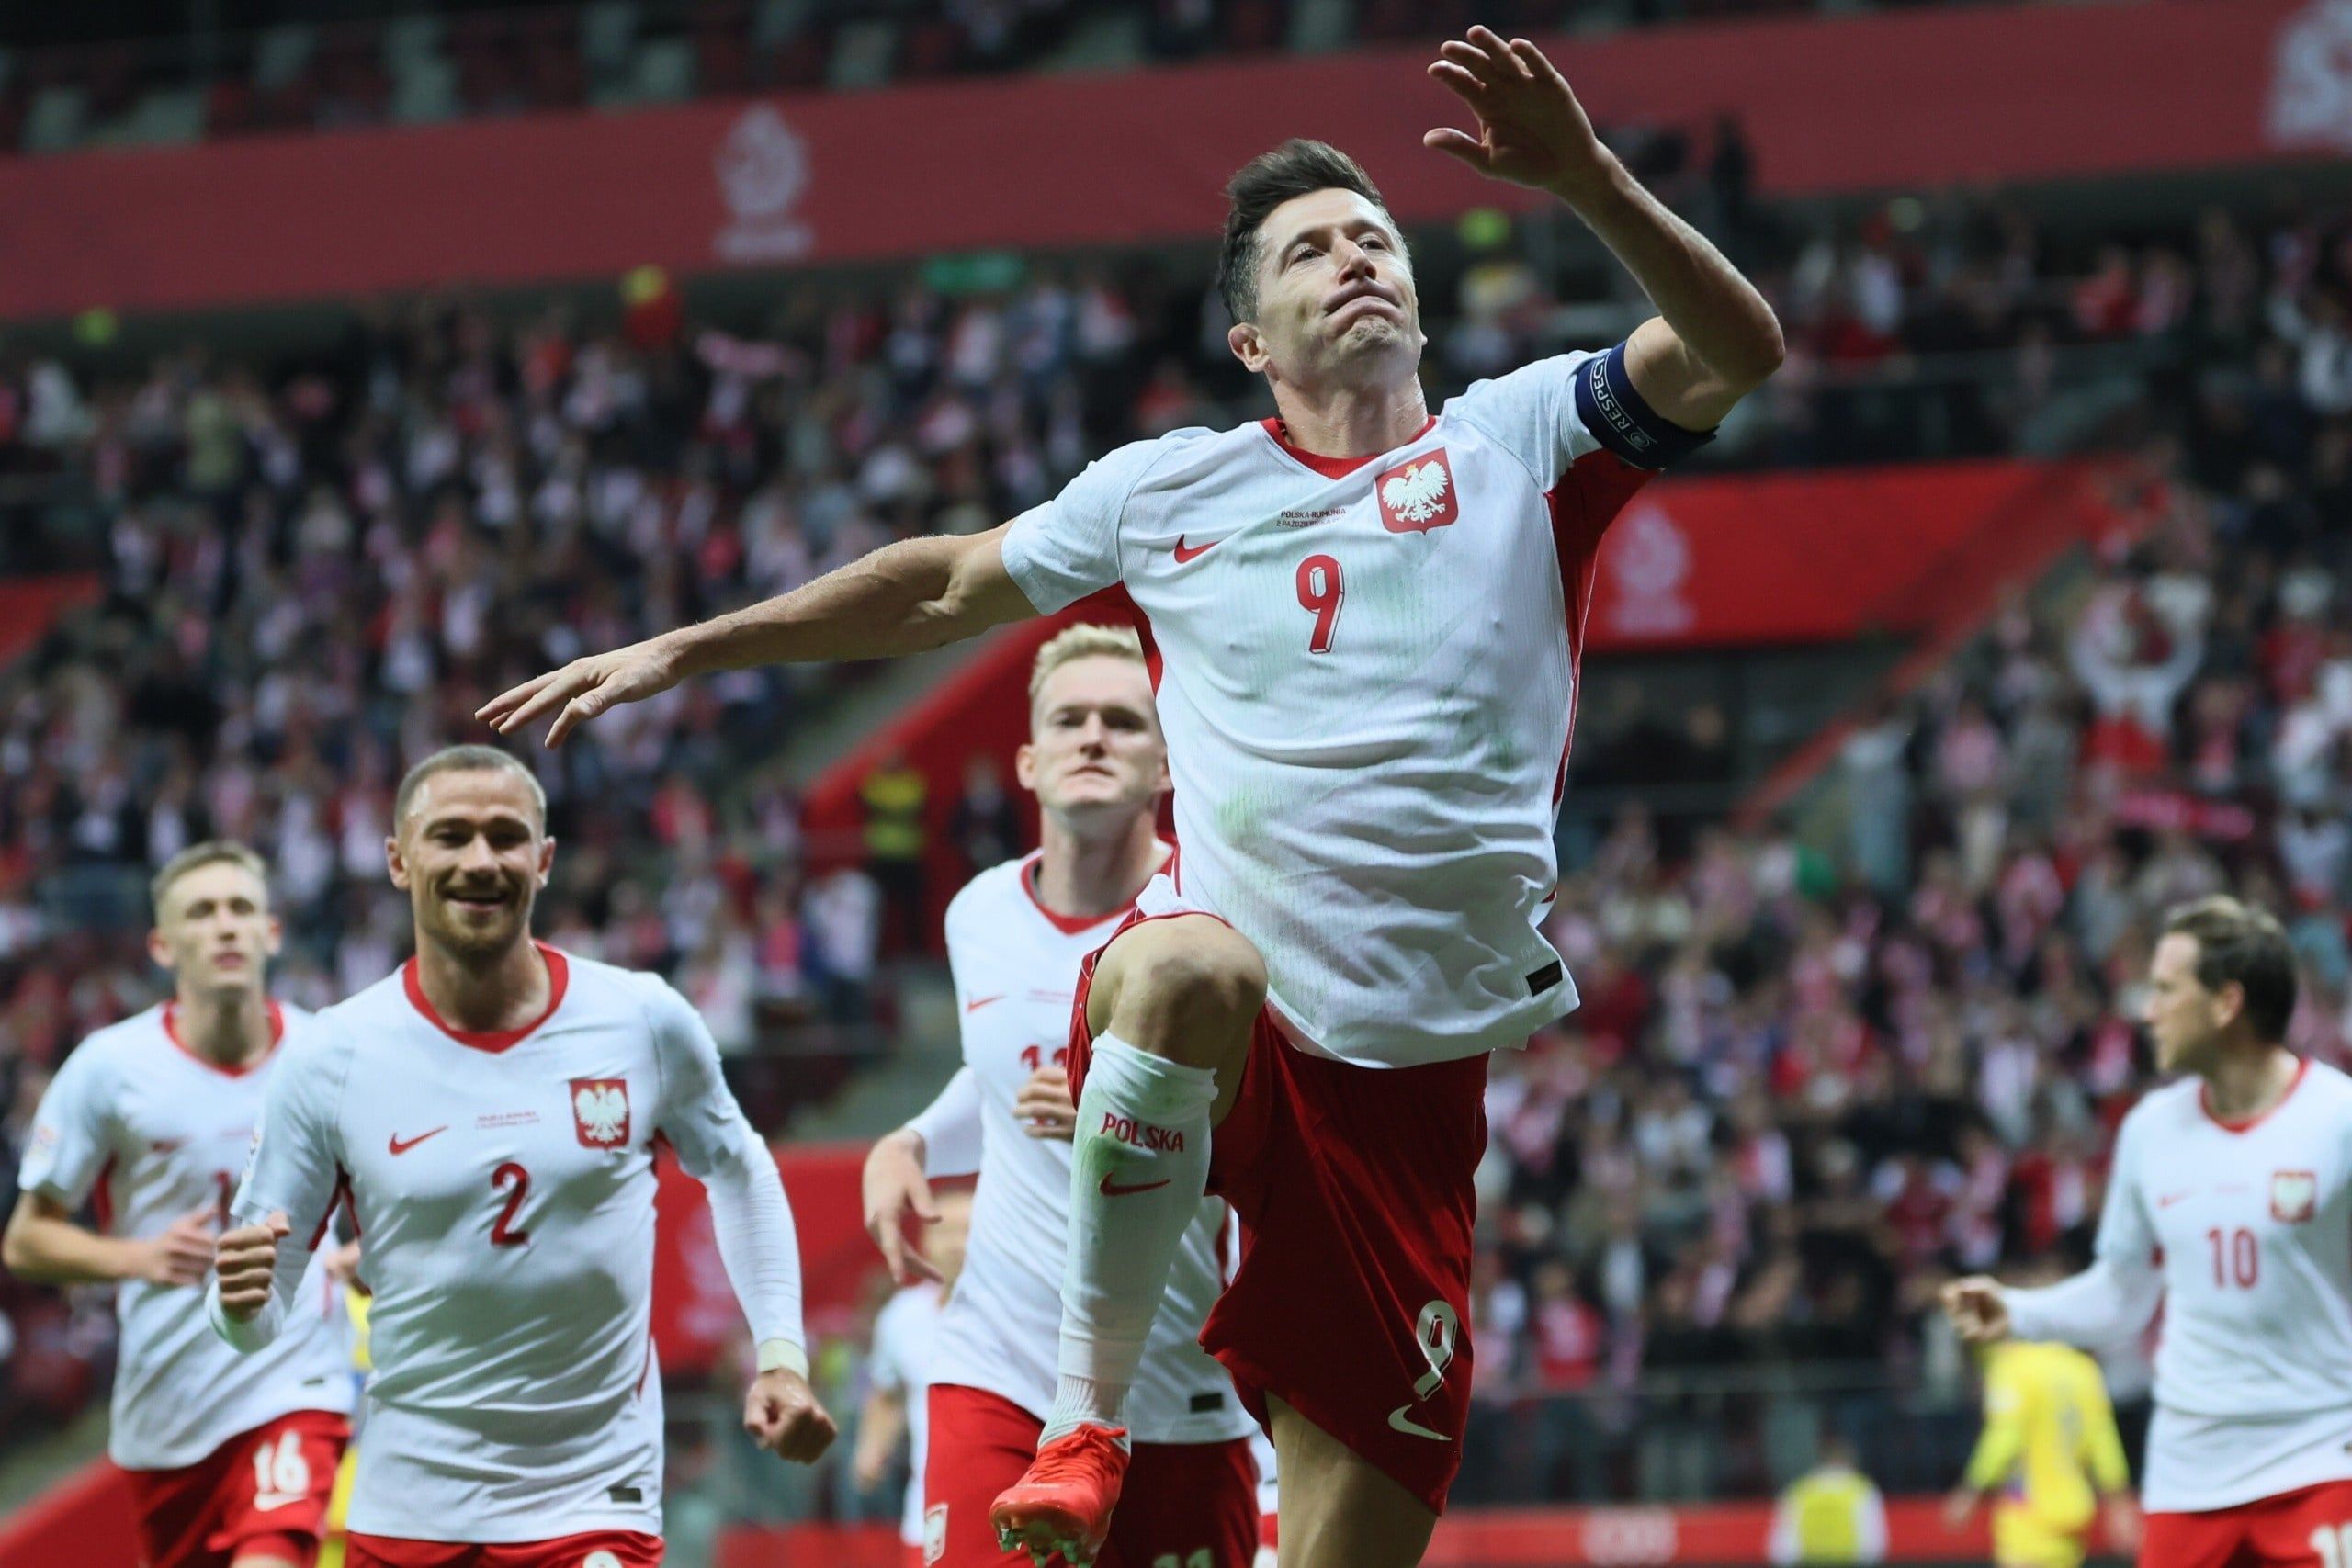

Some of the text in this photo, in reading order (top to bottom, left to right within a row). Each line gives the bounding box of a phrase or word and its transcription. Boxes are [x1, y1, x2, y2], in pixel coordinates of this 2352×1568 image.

[1296, 554, 1344, 654] 9
[1101, 1111, 1183, 1152] POLSKA
[491, 1162, 531, 1247] 2
[2208, 1227, 2258, 1290] 10
[1414, 1300, 1458, 1401] 9
[253, 1427, 311, 1495] 16
